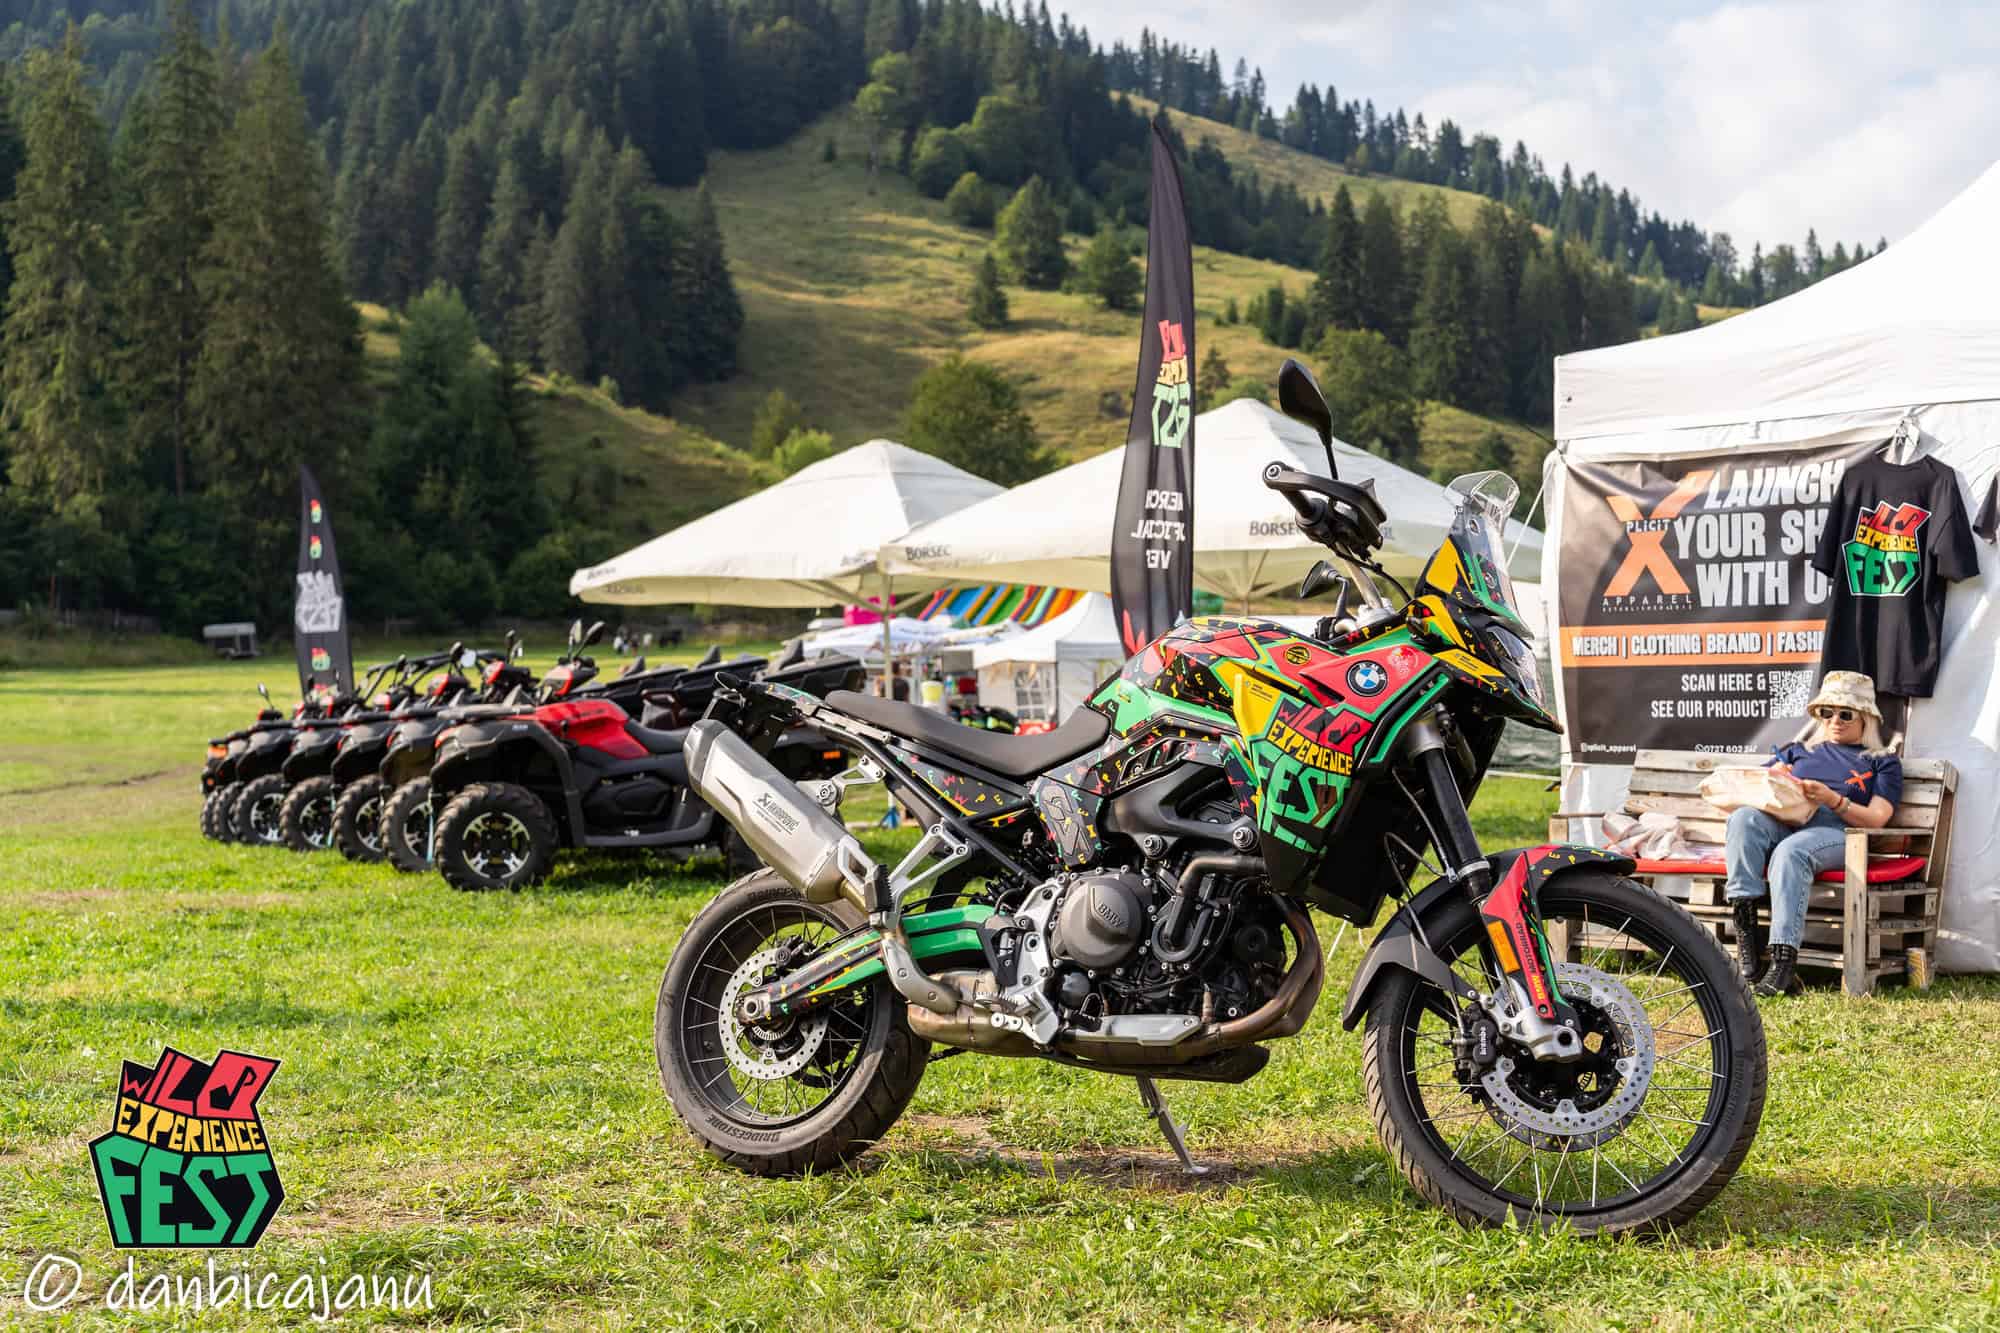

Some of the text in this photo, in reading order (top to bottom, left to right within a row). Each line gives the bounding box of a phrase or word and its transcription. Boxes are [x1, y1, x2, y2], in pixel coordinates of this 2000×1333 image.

[1704, 459, 1845, 509] LAUNCH
[1674, 512, 1766, 560] YOUR
[1855, 524, 1918, 553] EXPERIENCE
[1696, 560, 1834, 607] WITH U
[1846, 543, 1920, 594] FEST
[1602, 594, 1693, 606] APPAREL
[1573, 636, 1618, 657] MERCH
[1631, 632, 1700, 655] CLOTHING
[1706, 631, 1761, 654] BRAND
[1681, 673, 1767, 692] SCAN HERE &
[1651, 699, 1767, 718] SEE OUR PRODUCT
[1267, 719, 1353, 776] EXPERIENCE
[1252, 740, 1352, 833] FEST
[1515, 921, 1546, 1000] BMW MOTORRAD
